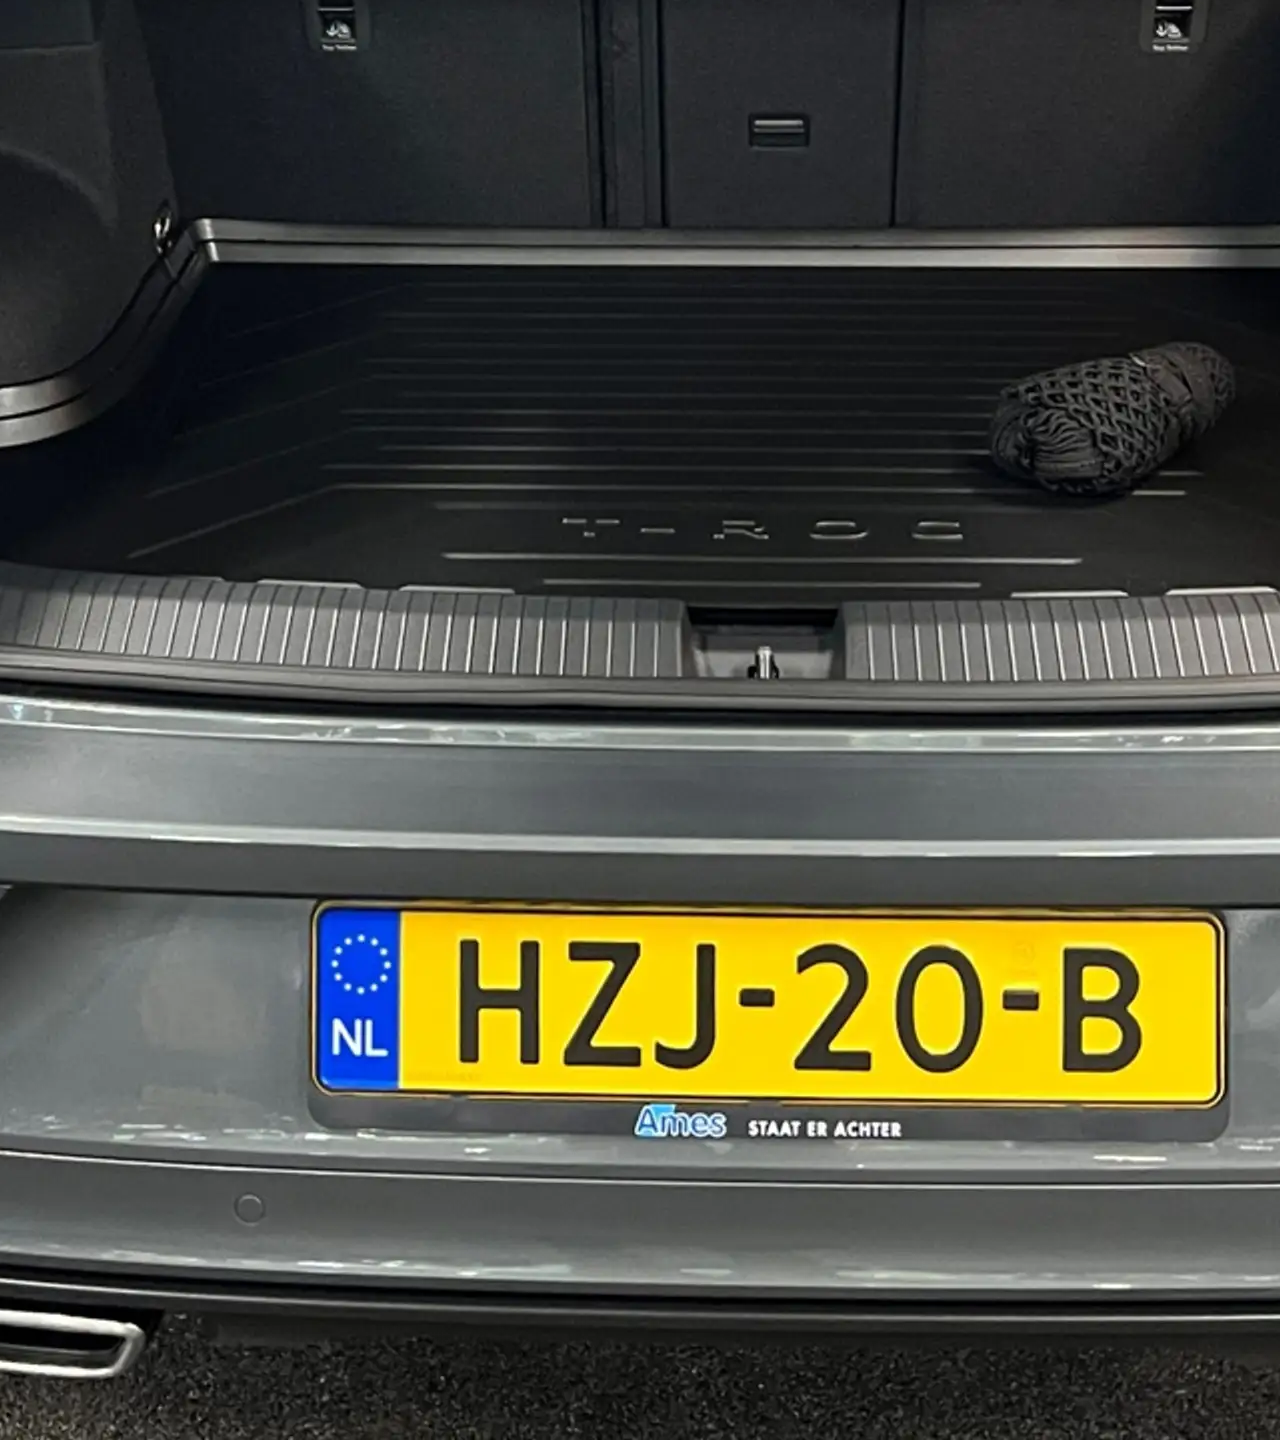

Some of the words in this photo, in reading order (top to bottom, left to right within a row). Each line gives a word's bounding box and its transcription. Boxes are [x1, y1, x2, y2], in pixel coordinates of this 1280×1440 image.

[458, 940, 1143, 1072] HZJ-20-B
[331, 1019, 388, 1057] NL
[634, 1103, 728, 1137] Ames
[747, 1120, 801, 1137] STAAT
[807, 1121, 828, 1137] ER
[833, 1120, 902, 1138] ACHTER
